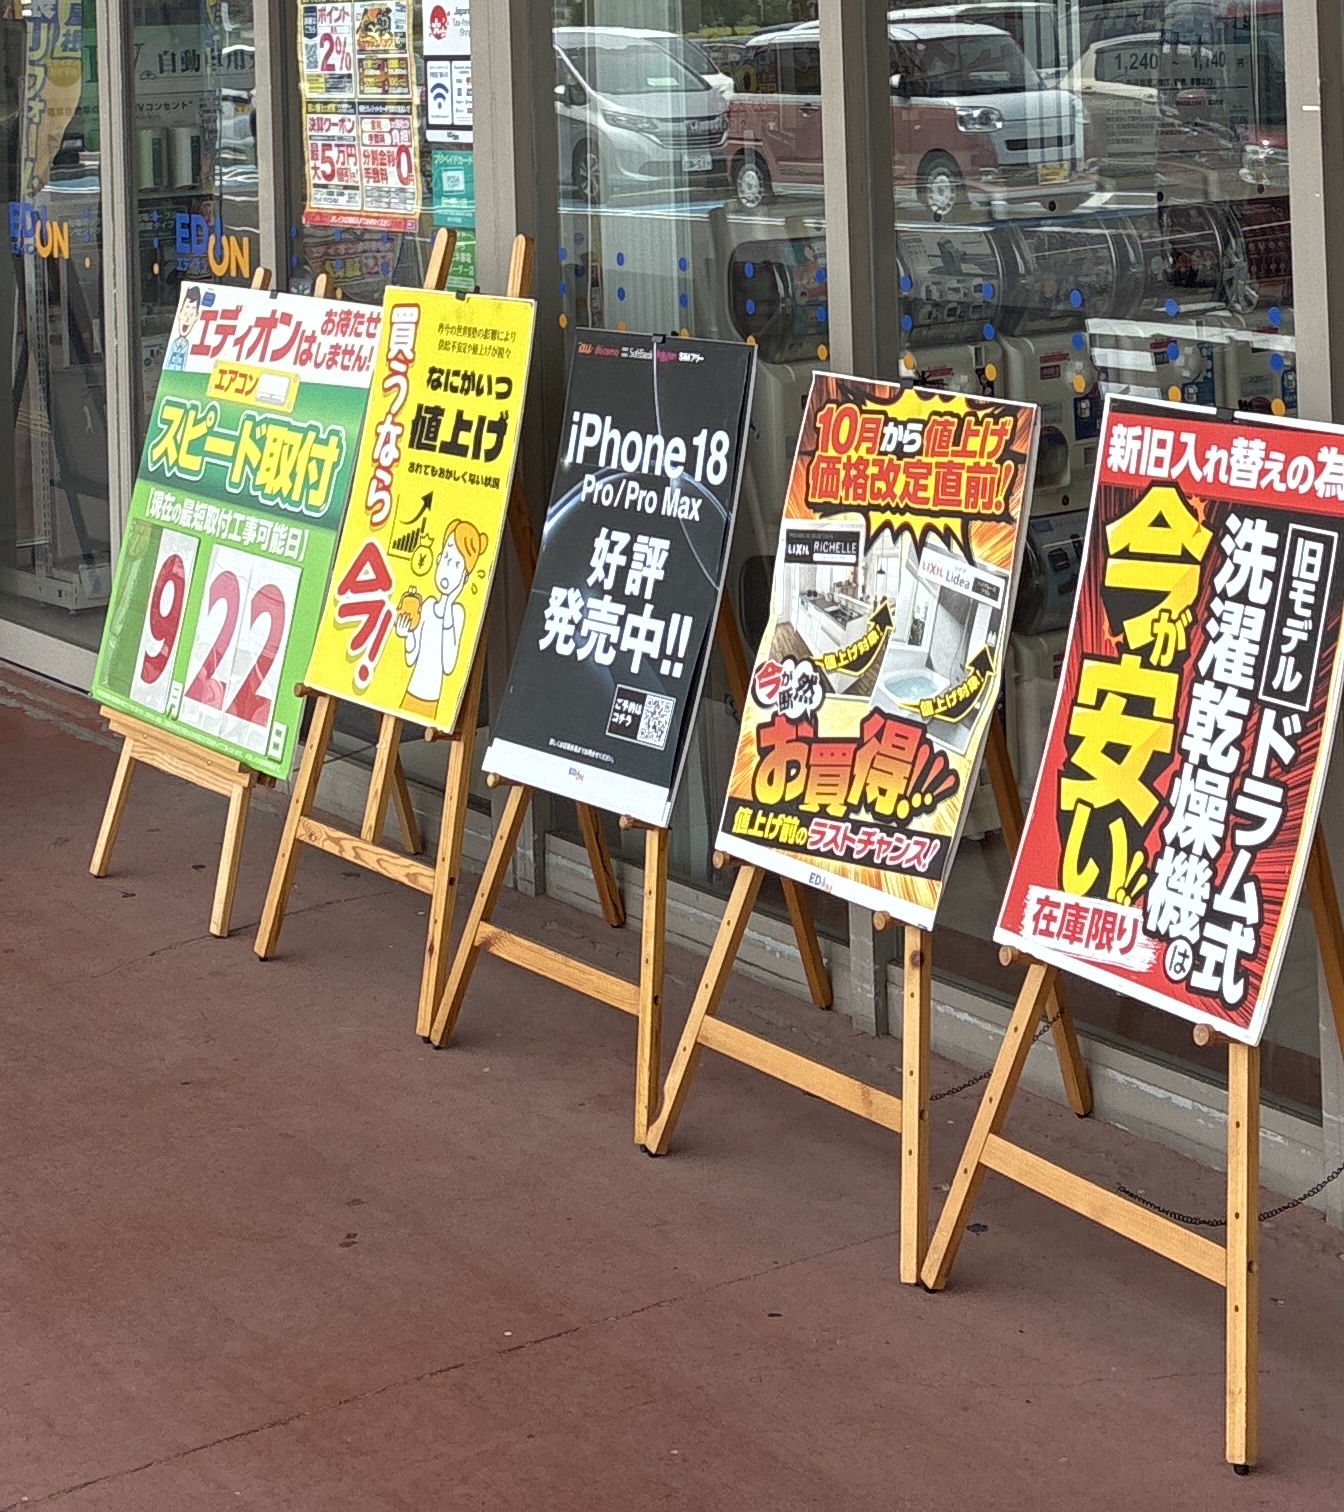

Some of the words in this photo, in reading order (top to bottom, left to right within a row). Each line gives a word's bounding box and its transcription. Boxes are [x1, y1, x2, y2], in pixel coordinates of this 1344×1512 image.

[317, 5, 351, 25] ポイント
[319, 32, 352, 72] 2%
[1114, 52, 1159, 72] 1,240
[175, 212, 250, 279] EDION
[189, 304, 318, 367] エディオンは
[320, 308, 382, 339] お待たせ
[213, 368, 260, 397] エアコン
[313, 341, 375, 373] しません!
[364, 302, 421, 529] 買うなら
[407, 402, 509, 464] 値上げ
[815, 402, 1012, 461] 10月から値上げ
[149, 400, 343, 512] スピード取付
[564, 410, 687, 481] iPhone
[692, 428, 731, 486] 18
[660, 488, 702, 523] Max
[807, 454, 1016, 514] 価格改定直前!
[586, 526, 672, 601] 好評
[787, 543, 810, 557] LIXIL
[813, 540, 858, 555] RICHELLE
[921, 560, 945, 579] LIXIL
[945, 569, 971, 590] Lidea
[538, 585, 694, 680] 発売中!!
[1271, 536, 1324, 693] 旧モデル
[1190, 709, 1303, 1007] ドラム式
[1030, 895, 1142, 956] 在庫限り
